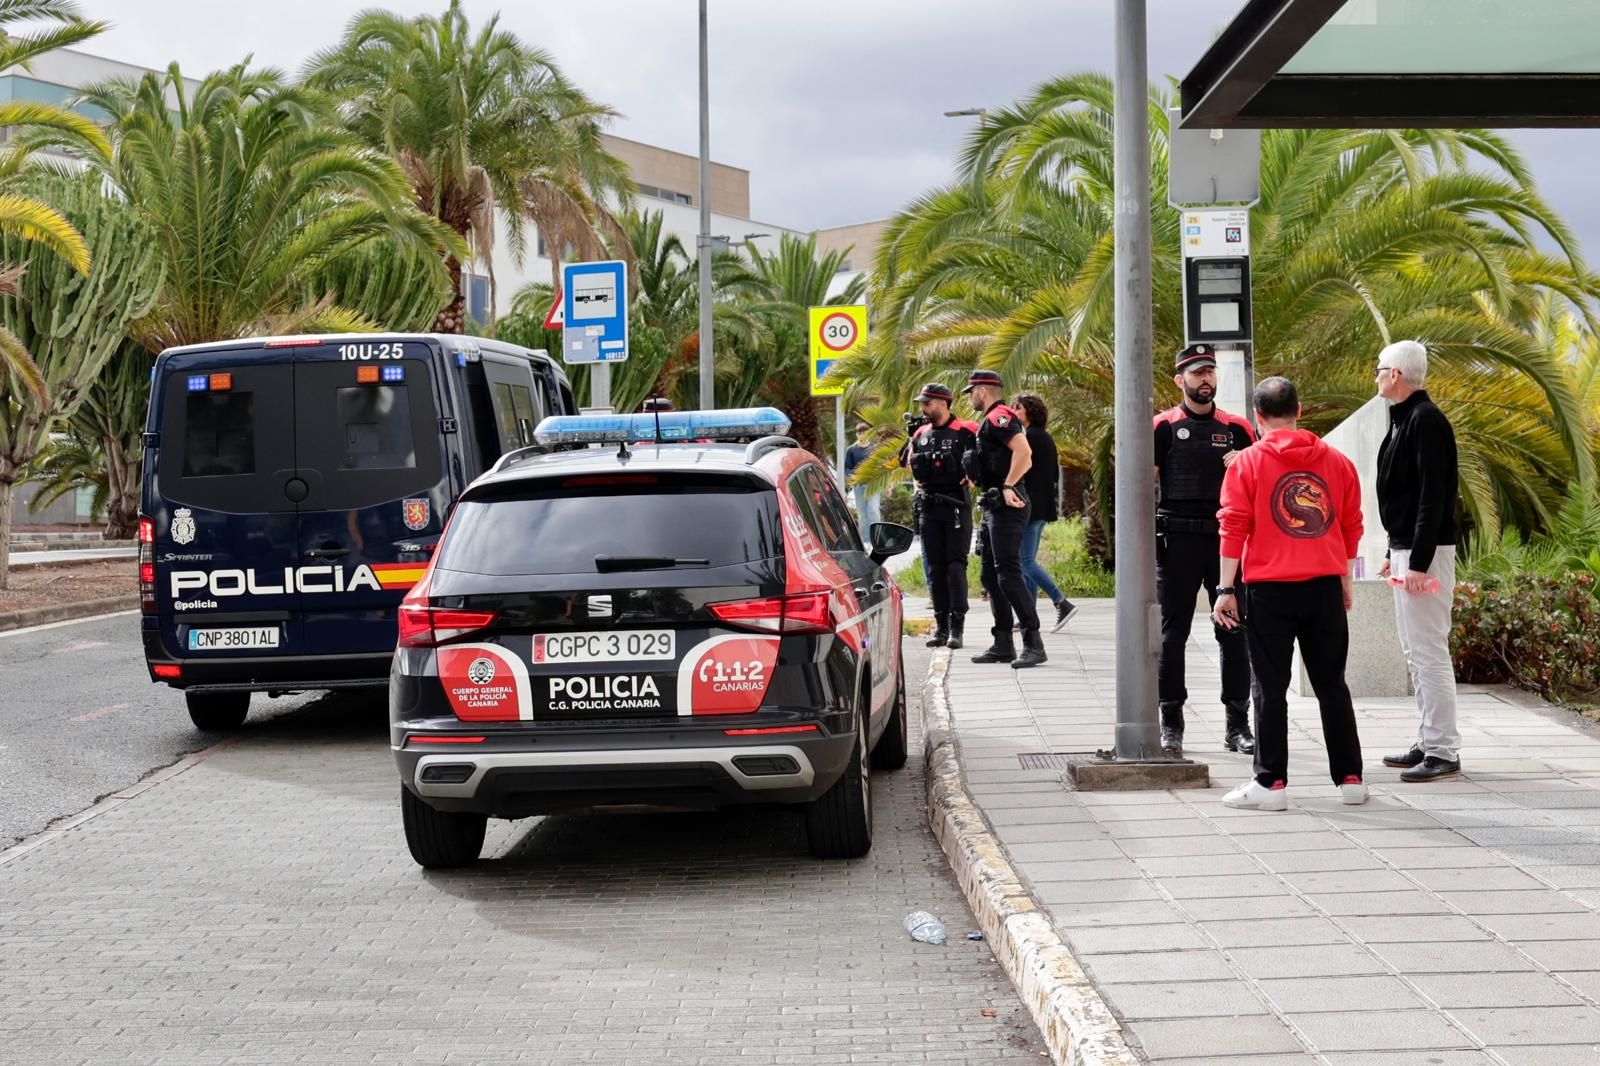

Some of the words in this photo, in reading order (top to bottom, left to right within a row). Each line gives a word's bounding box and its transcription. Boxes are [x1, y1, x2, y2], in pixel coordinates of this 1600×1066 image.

[828, 325, 849, 338] 30
[338, 342, 404, 361] 10U-25
[170, 564, 382, 599] POLICIA
[173, 599, 218, 611] @policia
[546, 635, 601, 658] CGPC
[607, 634, 620, 656] 3
[627, 633, 672, 656] 029
[452, 687, 480, 695] CUERPO
[480, 686, 513, 694] GENERAL
[548, 675, 661, 699] POLICIA
[713, 681, 765, 692] CANARIAS
[467, 700, 499, 708] CANARIA
[548, 701, 570, 710] C.G.
[571, 700, 612, 710] POLICIA
[614, 698, 661, 709] CANARIA
